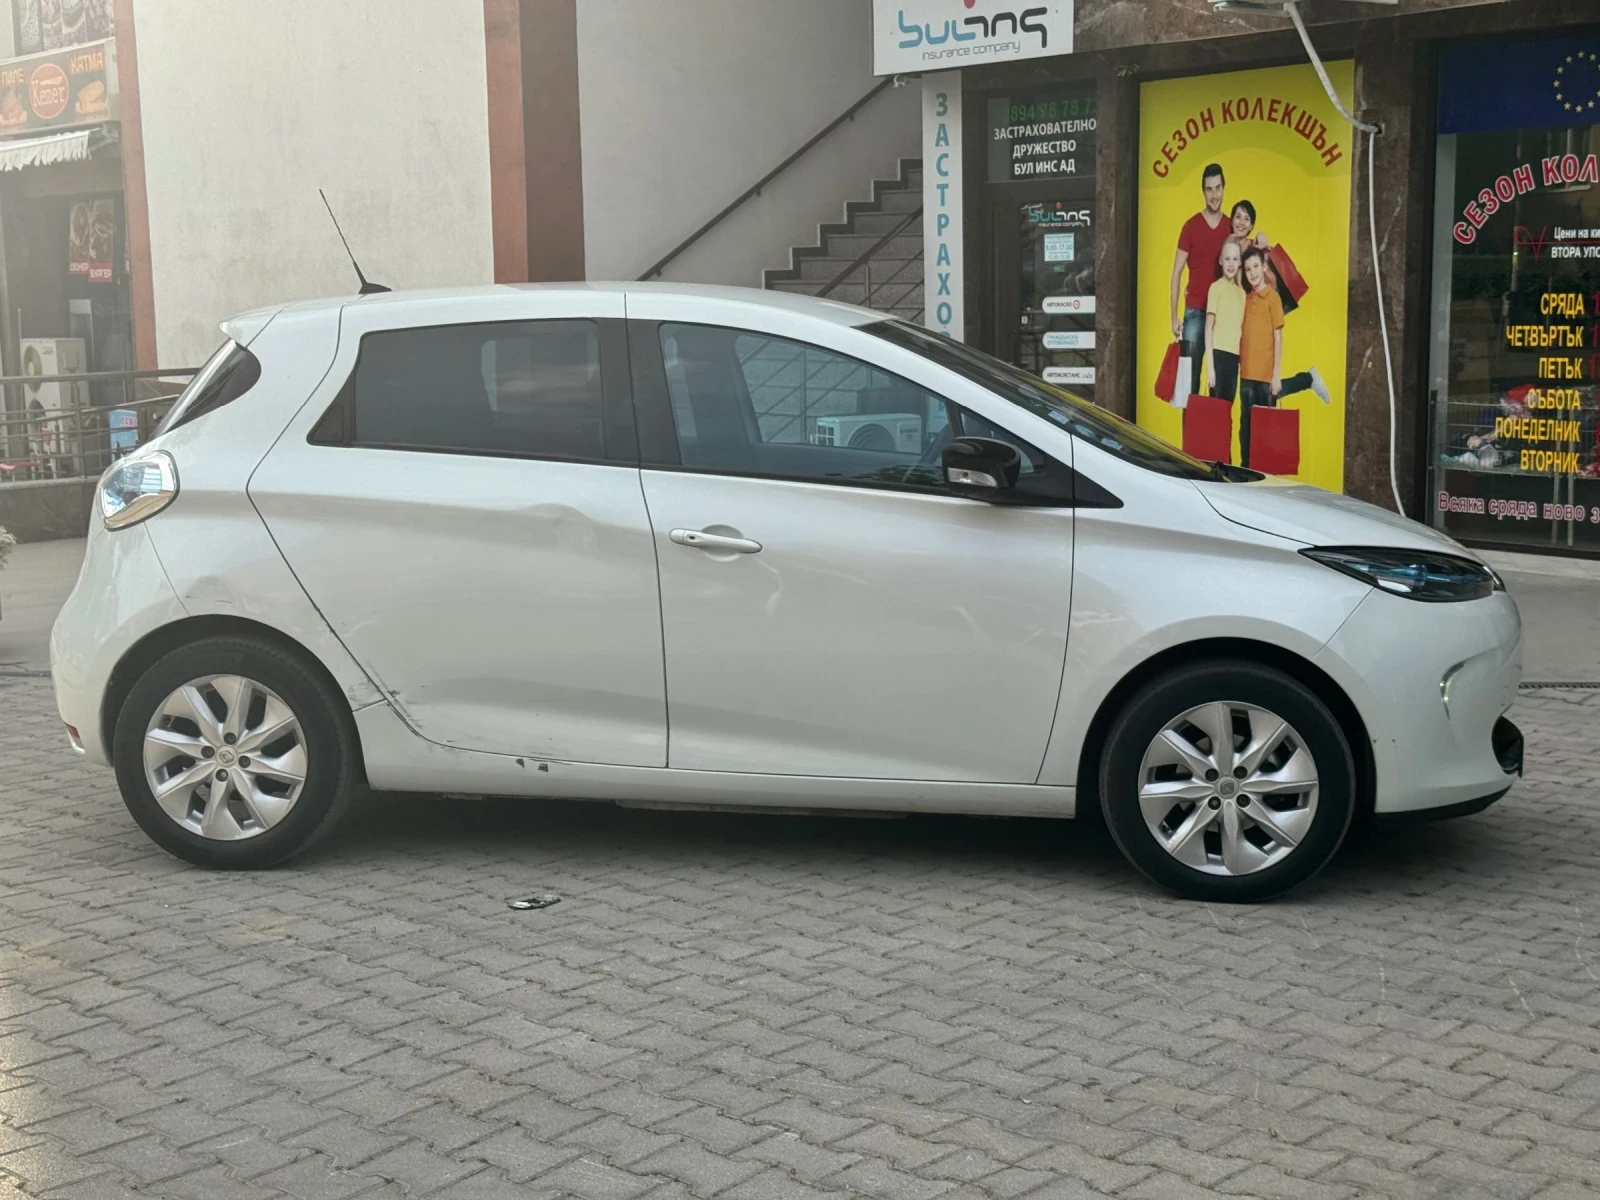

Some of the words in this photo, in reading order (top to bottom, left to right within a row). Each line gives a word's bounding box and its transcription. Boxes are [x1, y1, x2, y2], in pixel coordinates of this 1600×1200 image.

[921, 46, 971, 61] insurance
[972, 40, 1021, 55] company
[993, 117, 1097, 141] ЗАСТРАХОВАТЕЛНО
[1152, 107, 1216, 179] СЕЗОН
[1221, 97, 1344, 168] КОЛЕКШЪН
[1012, 139, 1077, 160] ДРУЖЕСТВО
[1014, 161, 1035, 175] БУЛ
[1035, 160, 1058, 174] ИНС
[1059, 158, 1076, 173] АД
[934, 92, 953, 339] ЗАСТРАХО
[1453, 163, 1536, 245] СЕЗОН
[1554, 226, 1577, 241] Цени
[1578, 228, 1589, 239] на
[1551, 246, 1582, 259] ВТОРА
[1540, 292, 1585, 318] СРЯДА
[1506, 325, 1585, 348] ЧЕТВЪРТЪК
[1538, 357, 1583, 379] ПЕТЪК
[1527, 388, 1582, 411] СЪБОТА
[1495, 416, 1581, 443] ПОНЕДЕЛНИК
[1520, 449, 1580, 474] ВТОРНИК
[1438, 491, 1485, 515] Всяка
[1488, 498, 1538, 521] сряда
[1543, 503, 1586, 522] ново
